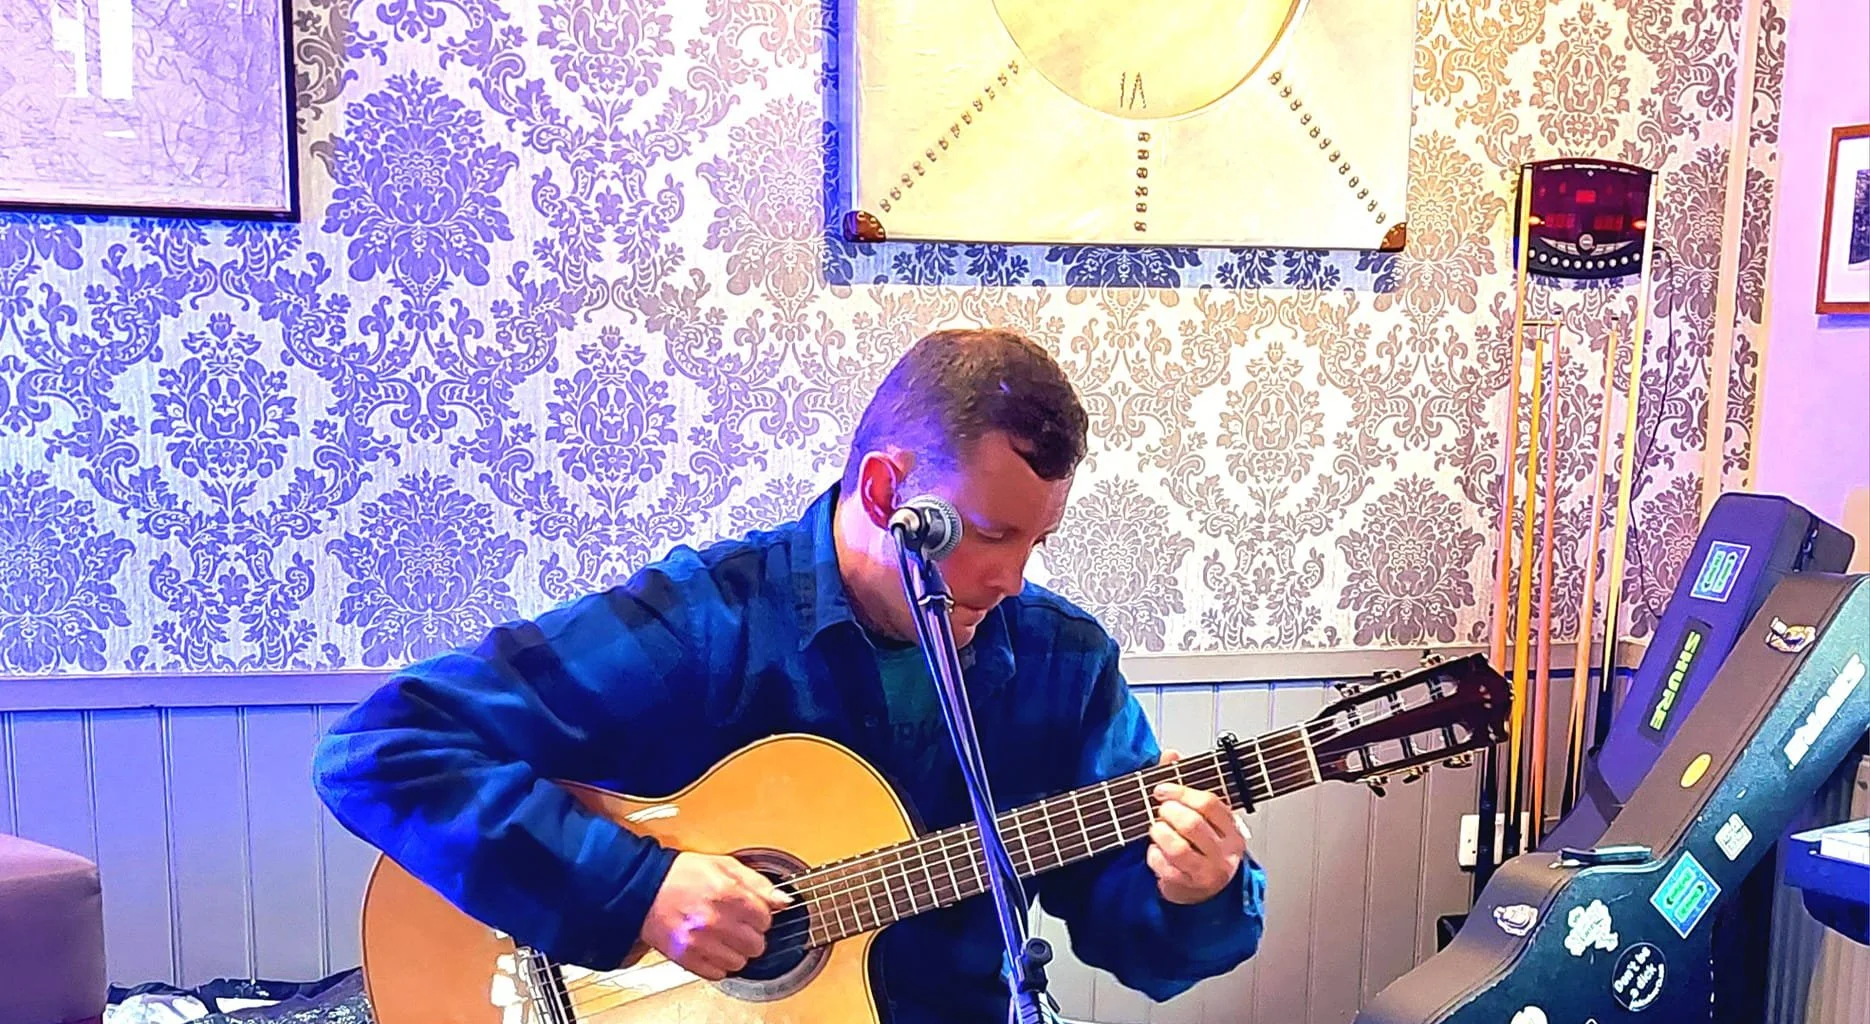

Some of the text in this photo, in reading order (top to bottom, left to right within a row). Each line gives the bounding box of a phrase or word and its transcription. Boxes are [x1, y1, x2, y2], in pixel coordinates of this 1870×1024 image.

[1650, 631, 1701, 730] SHURE
[1614, 961, 1640, 993] Don't
[1635, 946, 1651, 964] be
[1637, 963, 1657, 990] dick
